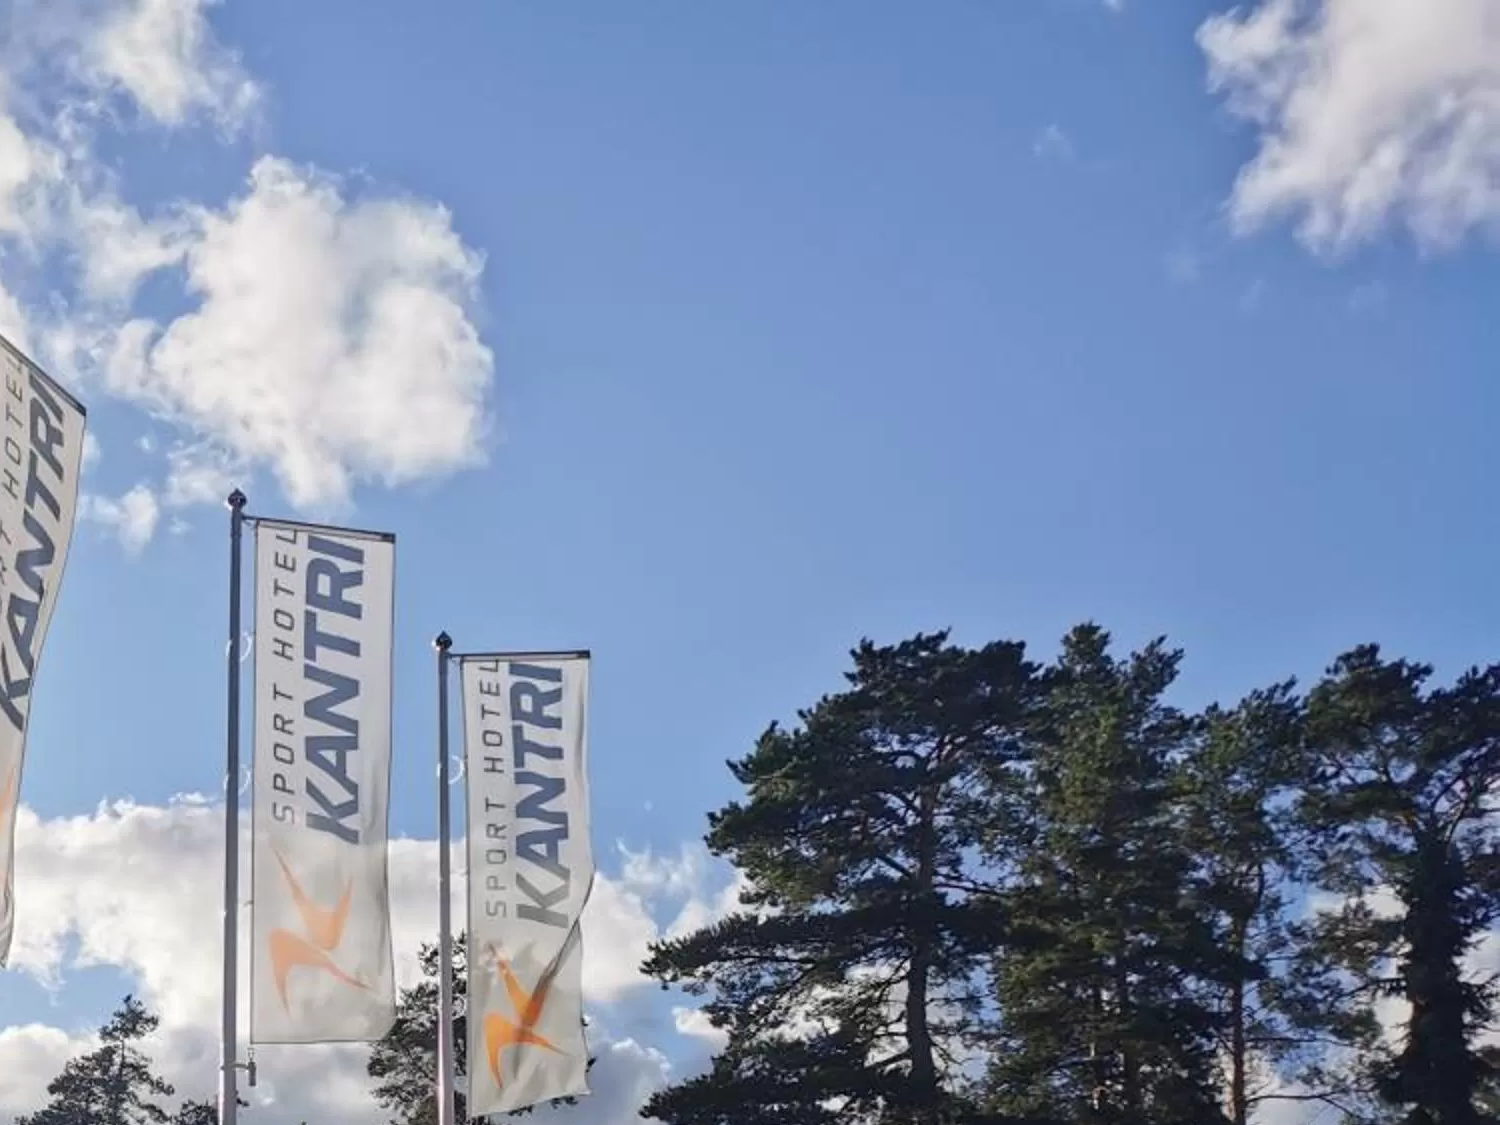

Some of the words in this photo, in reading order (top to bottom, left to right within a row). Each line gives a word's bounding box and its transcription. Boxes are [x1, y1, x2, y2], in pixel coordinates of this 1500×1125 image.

[2, 356, 23, 499] HOTEL
[273, 529, 297, 661] HOTEL
[273, 684, 295, 825] SPORT
[304, 534, 364, 845] KANTRI
[479, 659, 504, 774] HOTEL
[485, 797, 507, 918] SPORT
[509, 663, 570, 929] KANTRI
